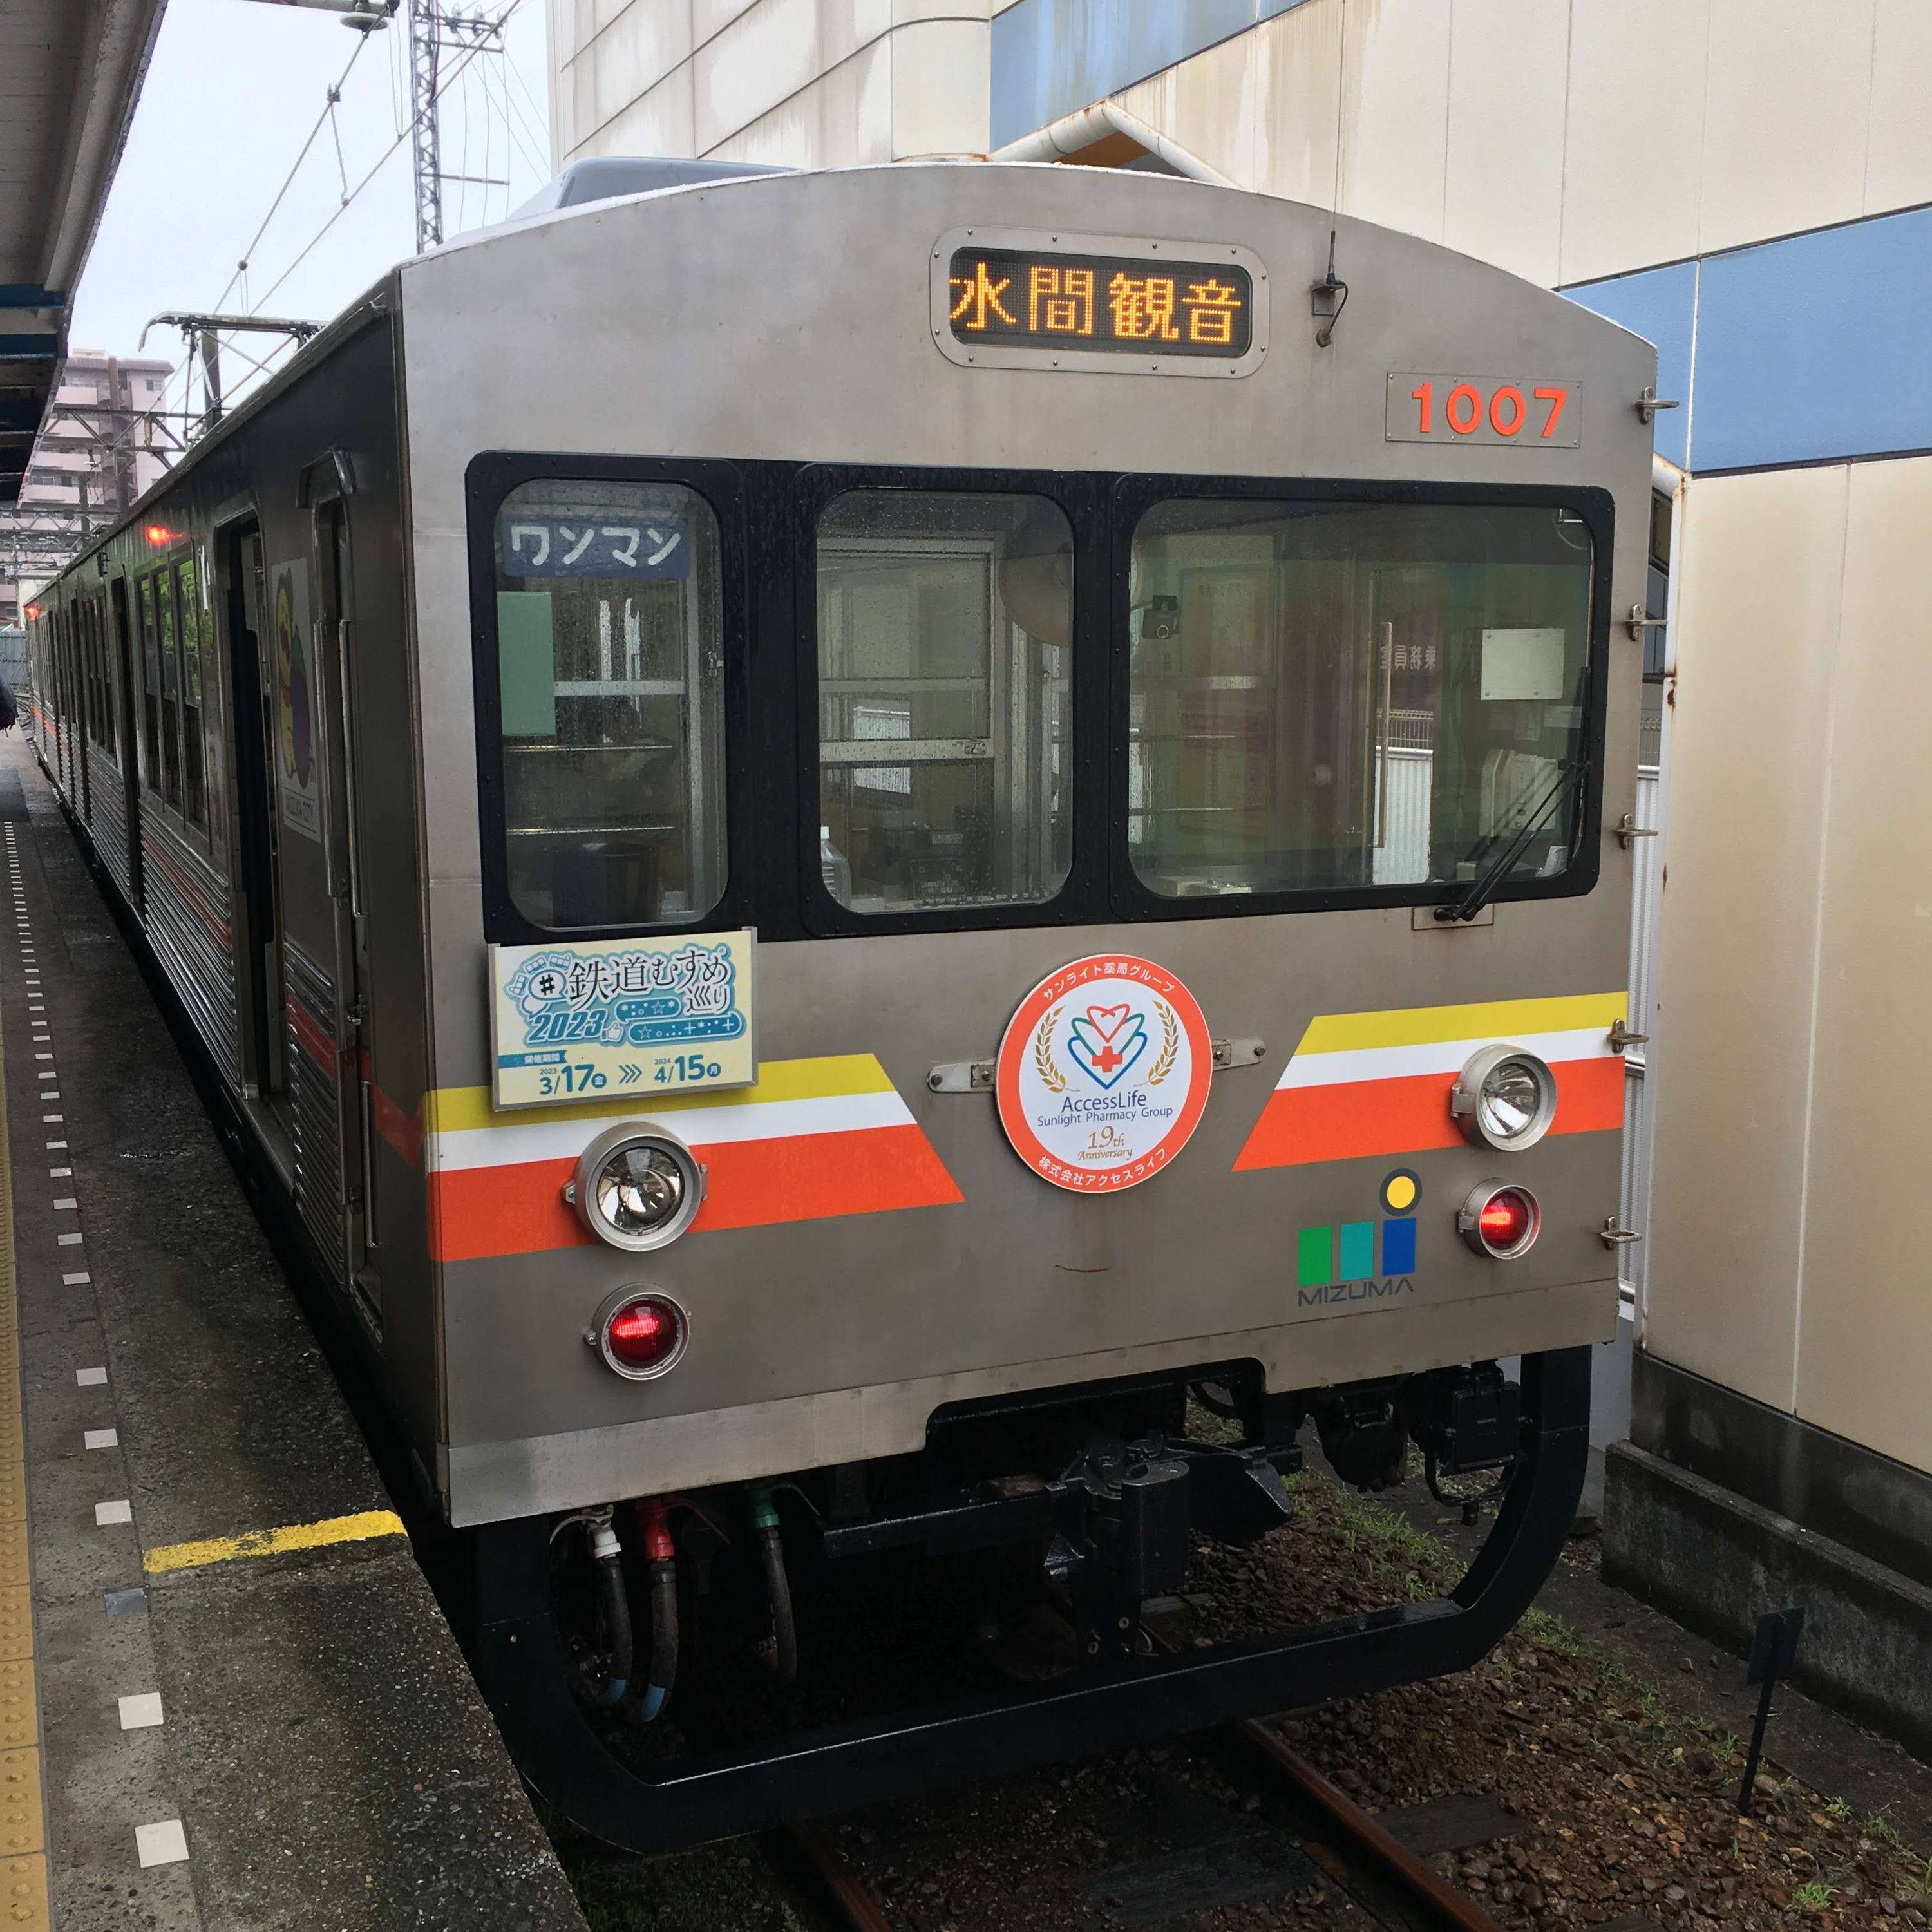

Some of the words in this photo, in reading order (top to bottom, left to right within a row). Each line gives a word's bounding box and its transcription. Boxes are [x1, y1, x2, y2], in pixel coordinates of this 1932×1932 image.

[949, 260, 1241, 343] 水間観音
[1411, 382, 1567, 438] 1007
[511, 526, 681, 567] ワンマン
[1043, 962, 1175, 1000] サンライト薬局グループ
[686, 985, 727, 1013] 巡り
[528, 1010, 607, 1042] 2023
[524, 1053, 560, 1065] 開催期間
[1037, 1113, 1081, 1127] Sunlight
[1086, 1110, 1137, 1122] Pharmacy
[1141, 1106, 1173, 1117] Group
[1061, 1090, 1147, 1113] AccessLife
[1088, 1126, 1125, 1149] 19th
[1037, 1148, 1166, 1187] 株式会社アクセスライフ
[1077, 1148, 1133, 1160] Anniversary
[1298, 1276, 1415, 1307] MIZUMA
